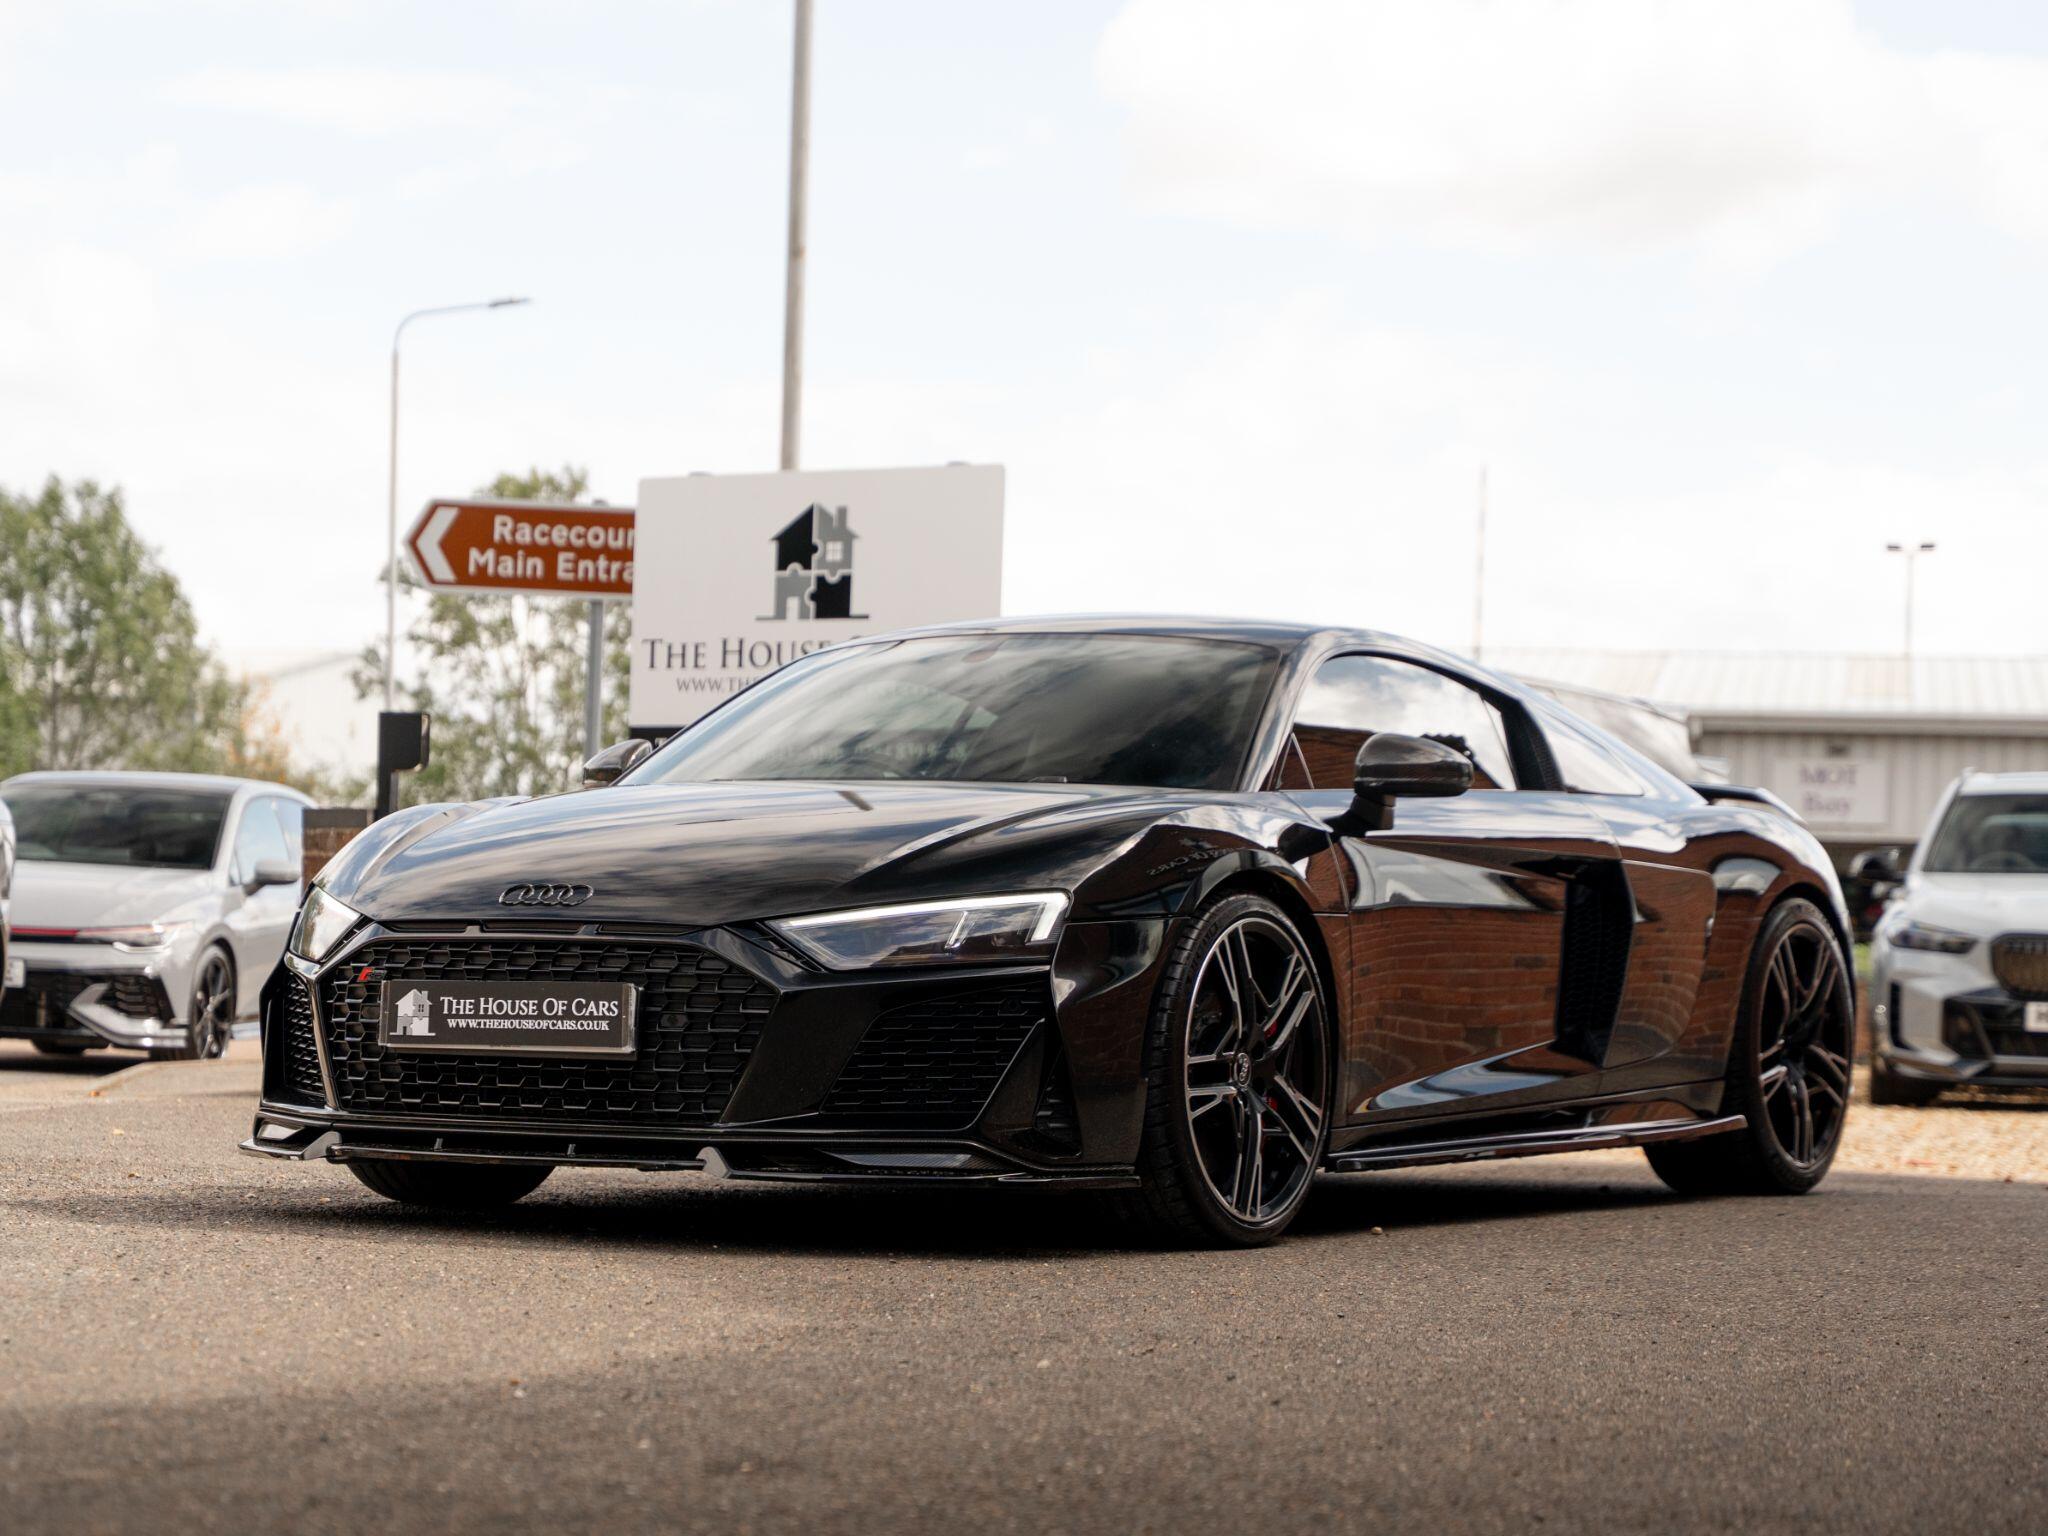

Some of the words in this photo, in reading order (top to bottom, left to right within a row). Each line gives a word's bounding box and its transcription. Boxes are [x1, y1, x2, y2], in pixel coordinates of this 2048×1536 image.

[468, 547, 544, 579] Main
[556, 551, 634, 584] Entra
[642, 637, 706, 669] THE
[440, 996, 475, 1015] THE
[479, 997, 539, 1016] HOUSE
[542, 997, 568, 1016] OF
[571, 998, 619, 1017] CARS
[447, 1018, 610, 1031] WWW.THEHOUSEOFCARS.CO.UK
